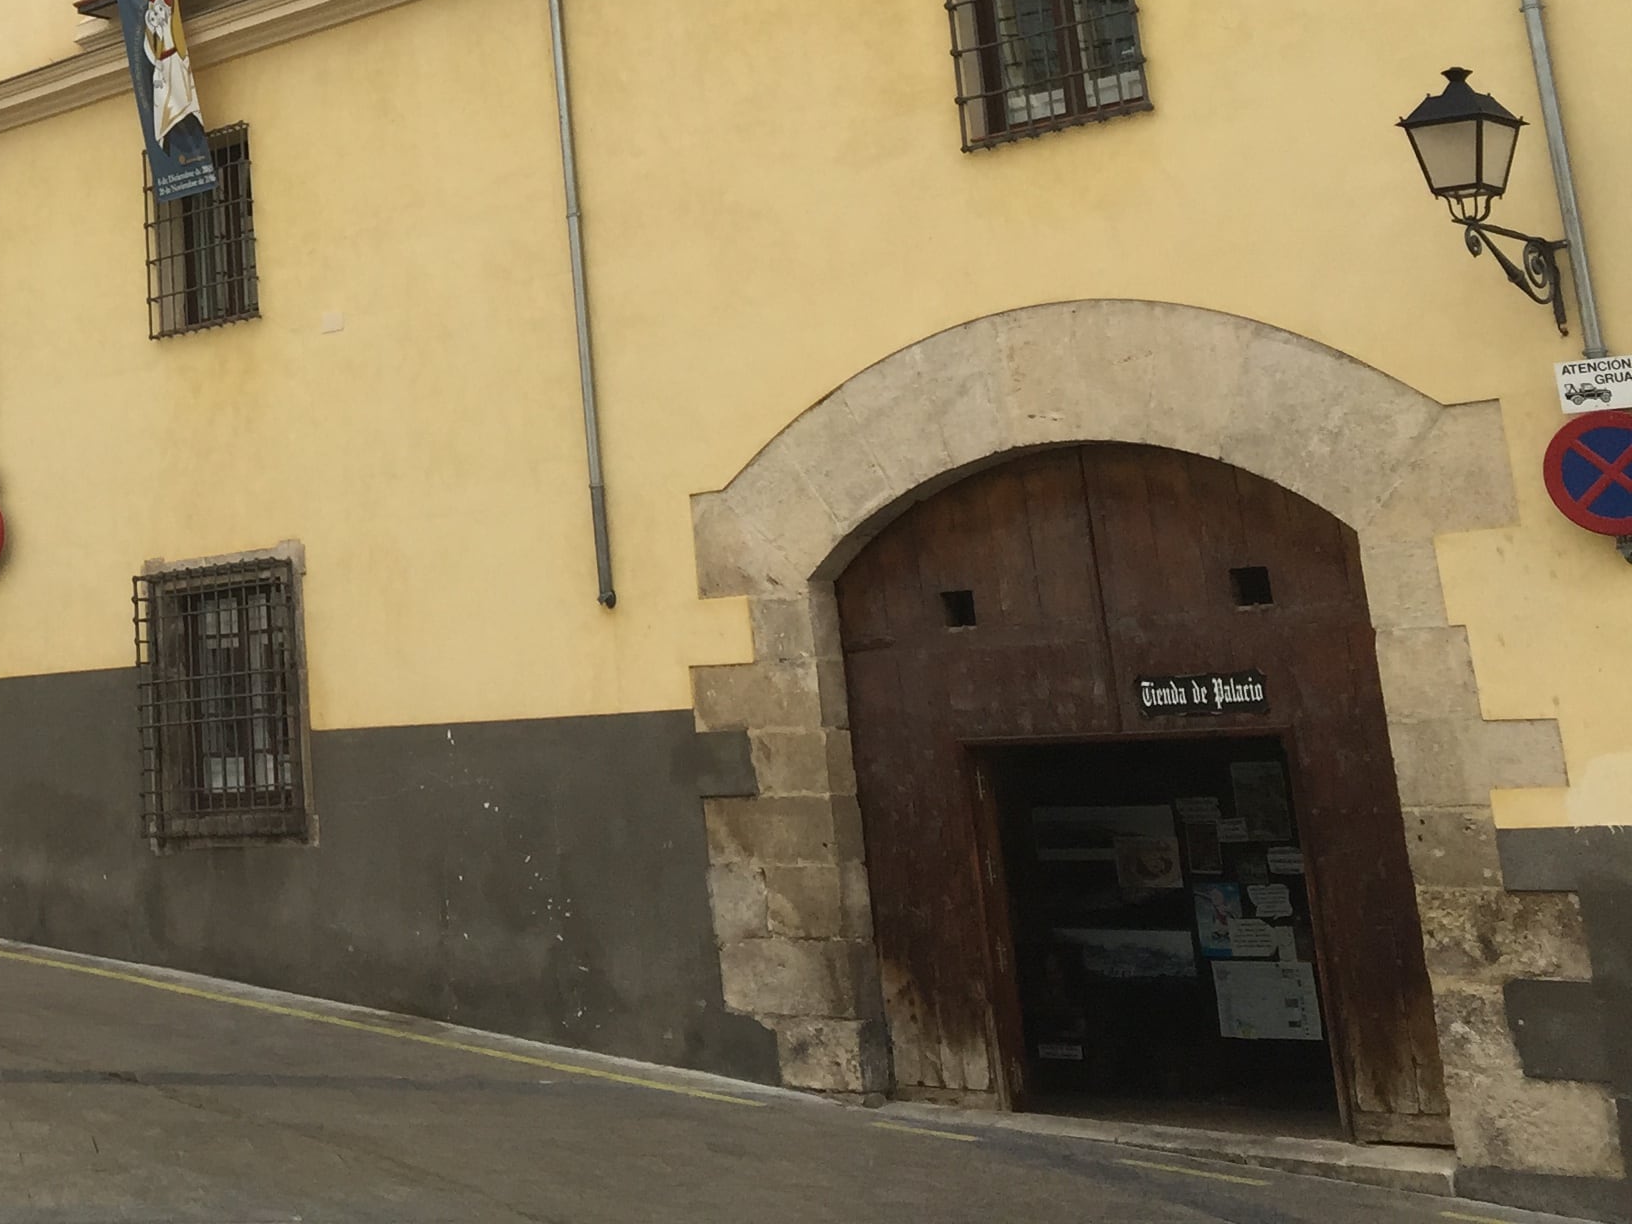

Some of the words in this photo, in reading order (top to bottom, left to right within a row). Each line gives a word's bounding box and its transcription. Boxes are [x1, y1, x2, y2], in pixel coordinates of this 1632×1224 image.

[1594, 372, 1632, 385] GRUA
[1141, 680, 1187, 707] Tienda
[1191, 679, 1208, 704] de
[1212, 676, 1264, 709] Palacio
